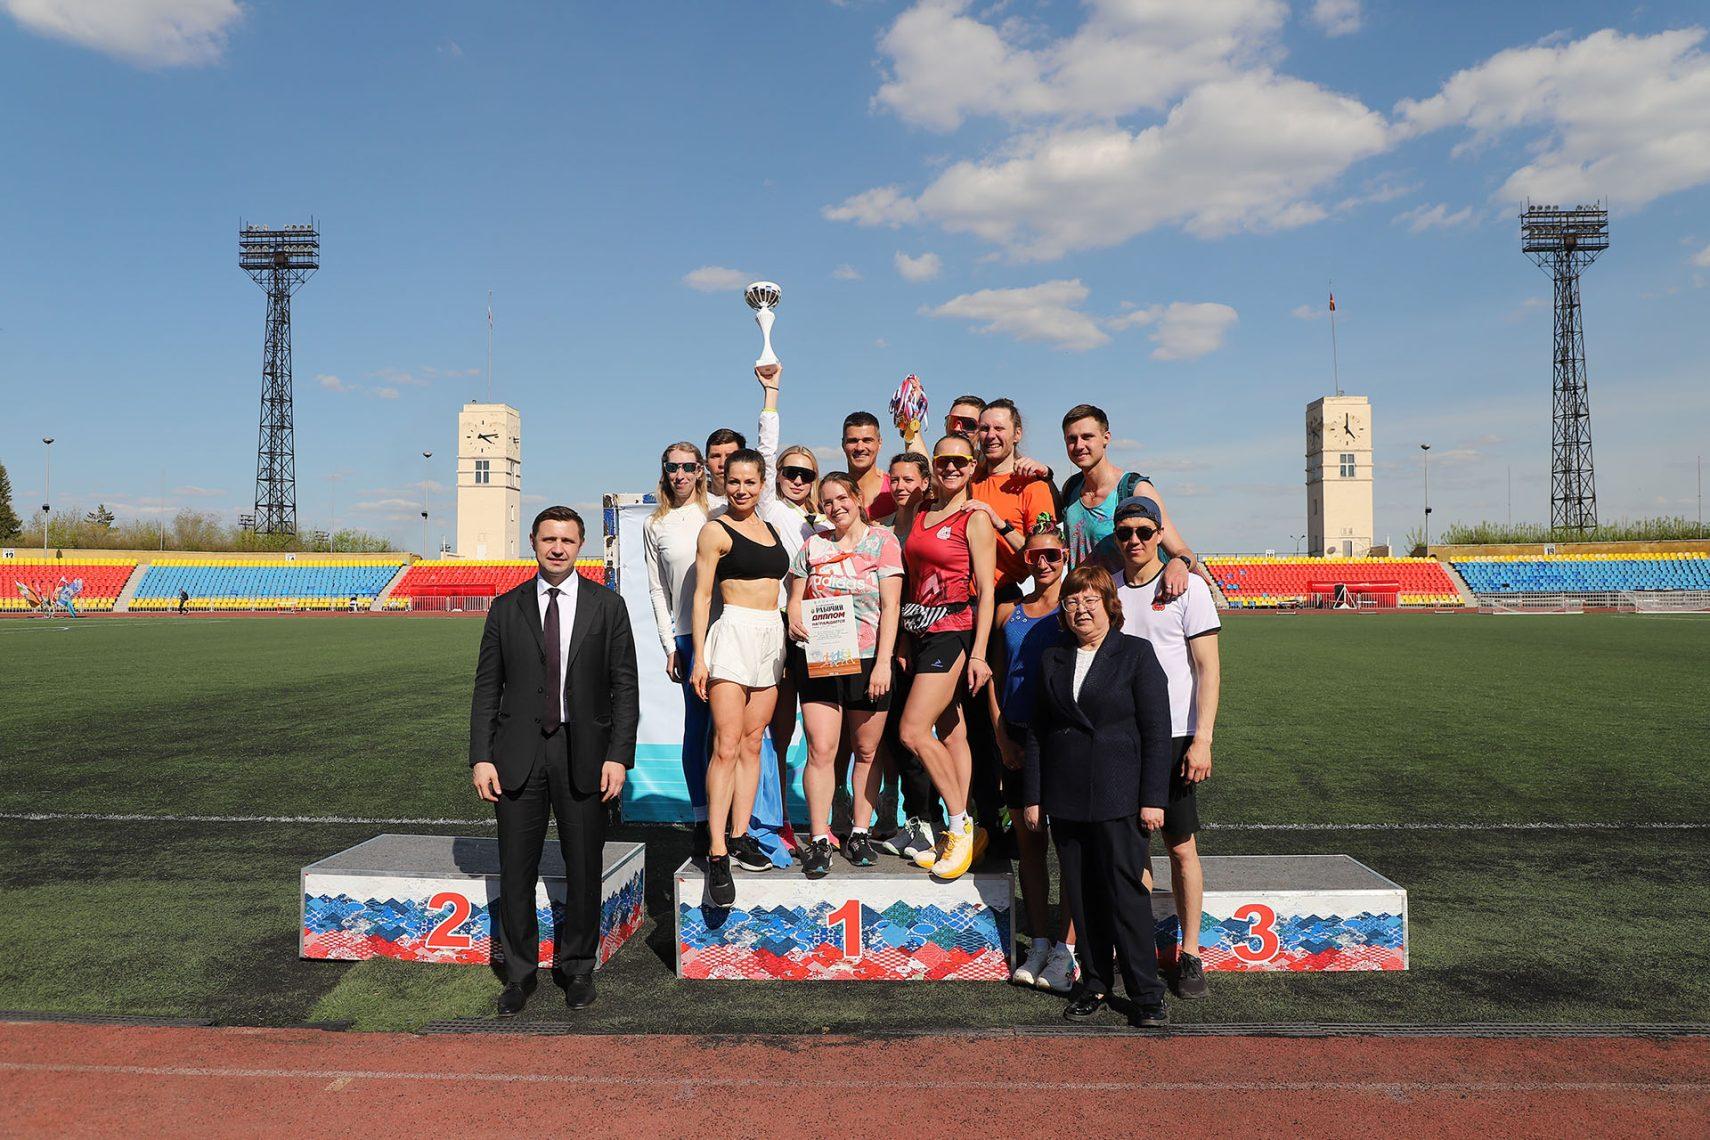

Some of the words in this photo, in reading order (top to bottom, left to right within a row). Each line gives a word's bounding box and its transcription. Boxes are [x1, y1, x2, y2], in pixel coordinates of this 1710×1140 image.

[813, 575, 865, 590] adidas
[812, 611, 845, 621] ДИПЛОМ
[426, 891, 470, 948] 2
[827, 899, 861, 957] 1
[1232, 903, 1279, 962] 3
